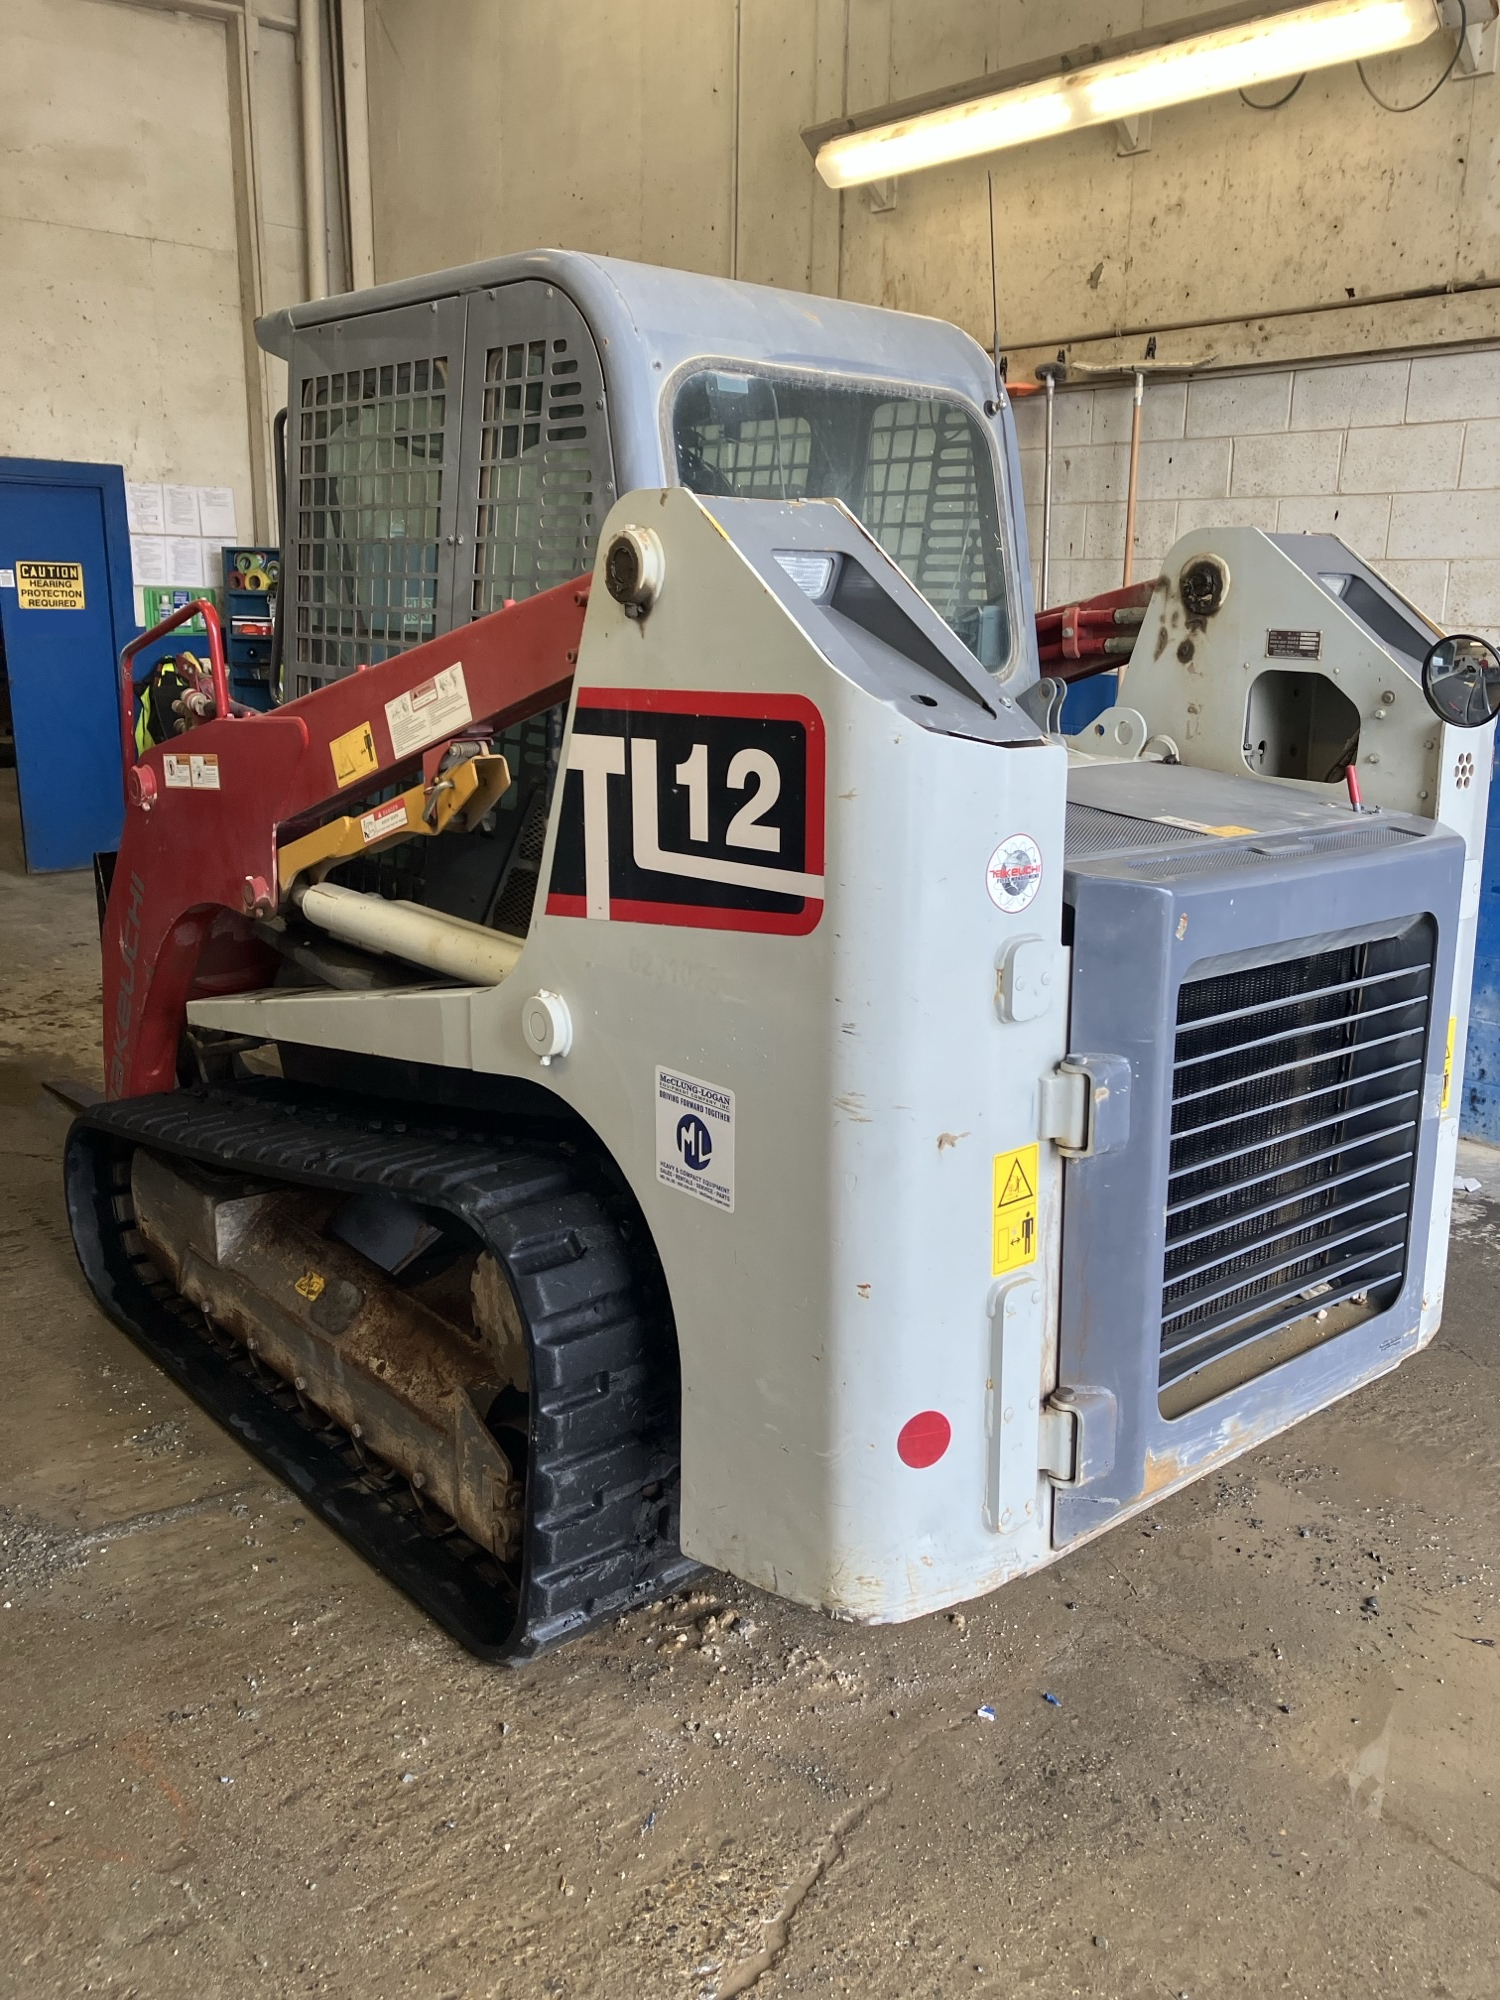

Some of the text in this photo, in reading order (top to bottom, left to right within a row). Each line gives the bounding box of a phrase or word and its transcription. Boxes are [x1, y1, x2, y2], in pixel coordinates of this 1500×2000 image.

[22, 565, 77, 578] CAUTION
[29, 580, 72, 588] HEARING
[21, 589, 82, 598] PROTECTION
[28, 599, 76, 608] REQUIRED
[406, 611, 430, 621] USD
[566, 733, 824, 920] TL12
[660, 1082, 689, 1095] EQUIPMENT
[660, 1074, 730, 1106] McCLUNG-LOGAN
[660, 1090, 730, 1122] DRIVING FORWARD TOGETHER
[660, 1161, 675, 1171] HEAVY
[680, 1169, 702, 1183] COMPACT
[702, 1178, 730, 1194] EQUIPMENT
[660, 1167, 672, 1177] SALES
[675, 1174, 693, 1186] RENTALS
[696, 1183, 713, 1195] SERVICE
[716, 1191, 730, 1202] PARTS
